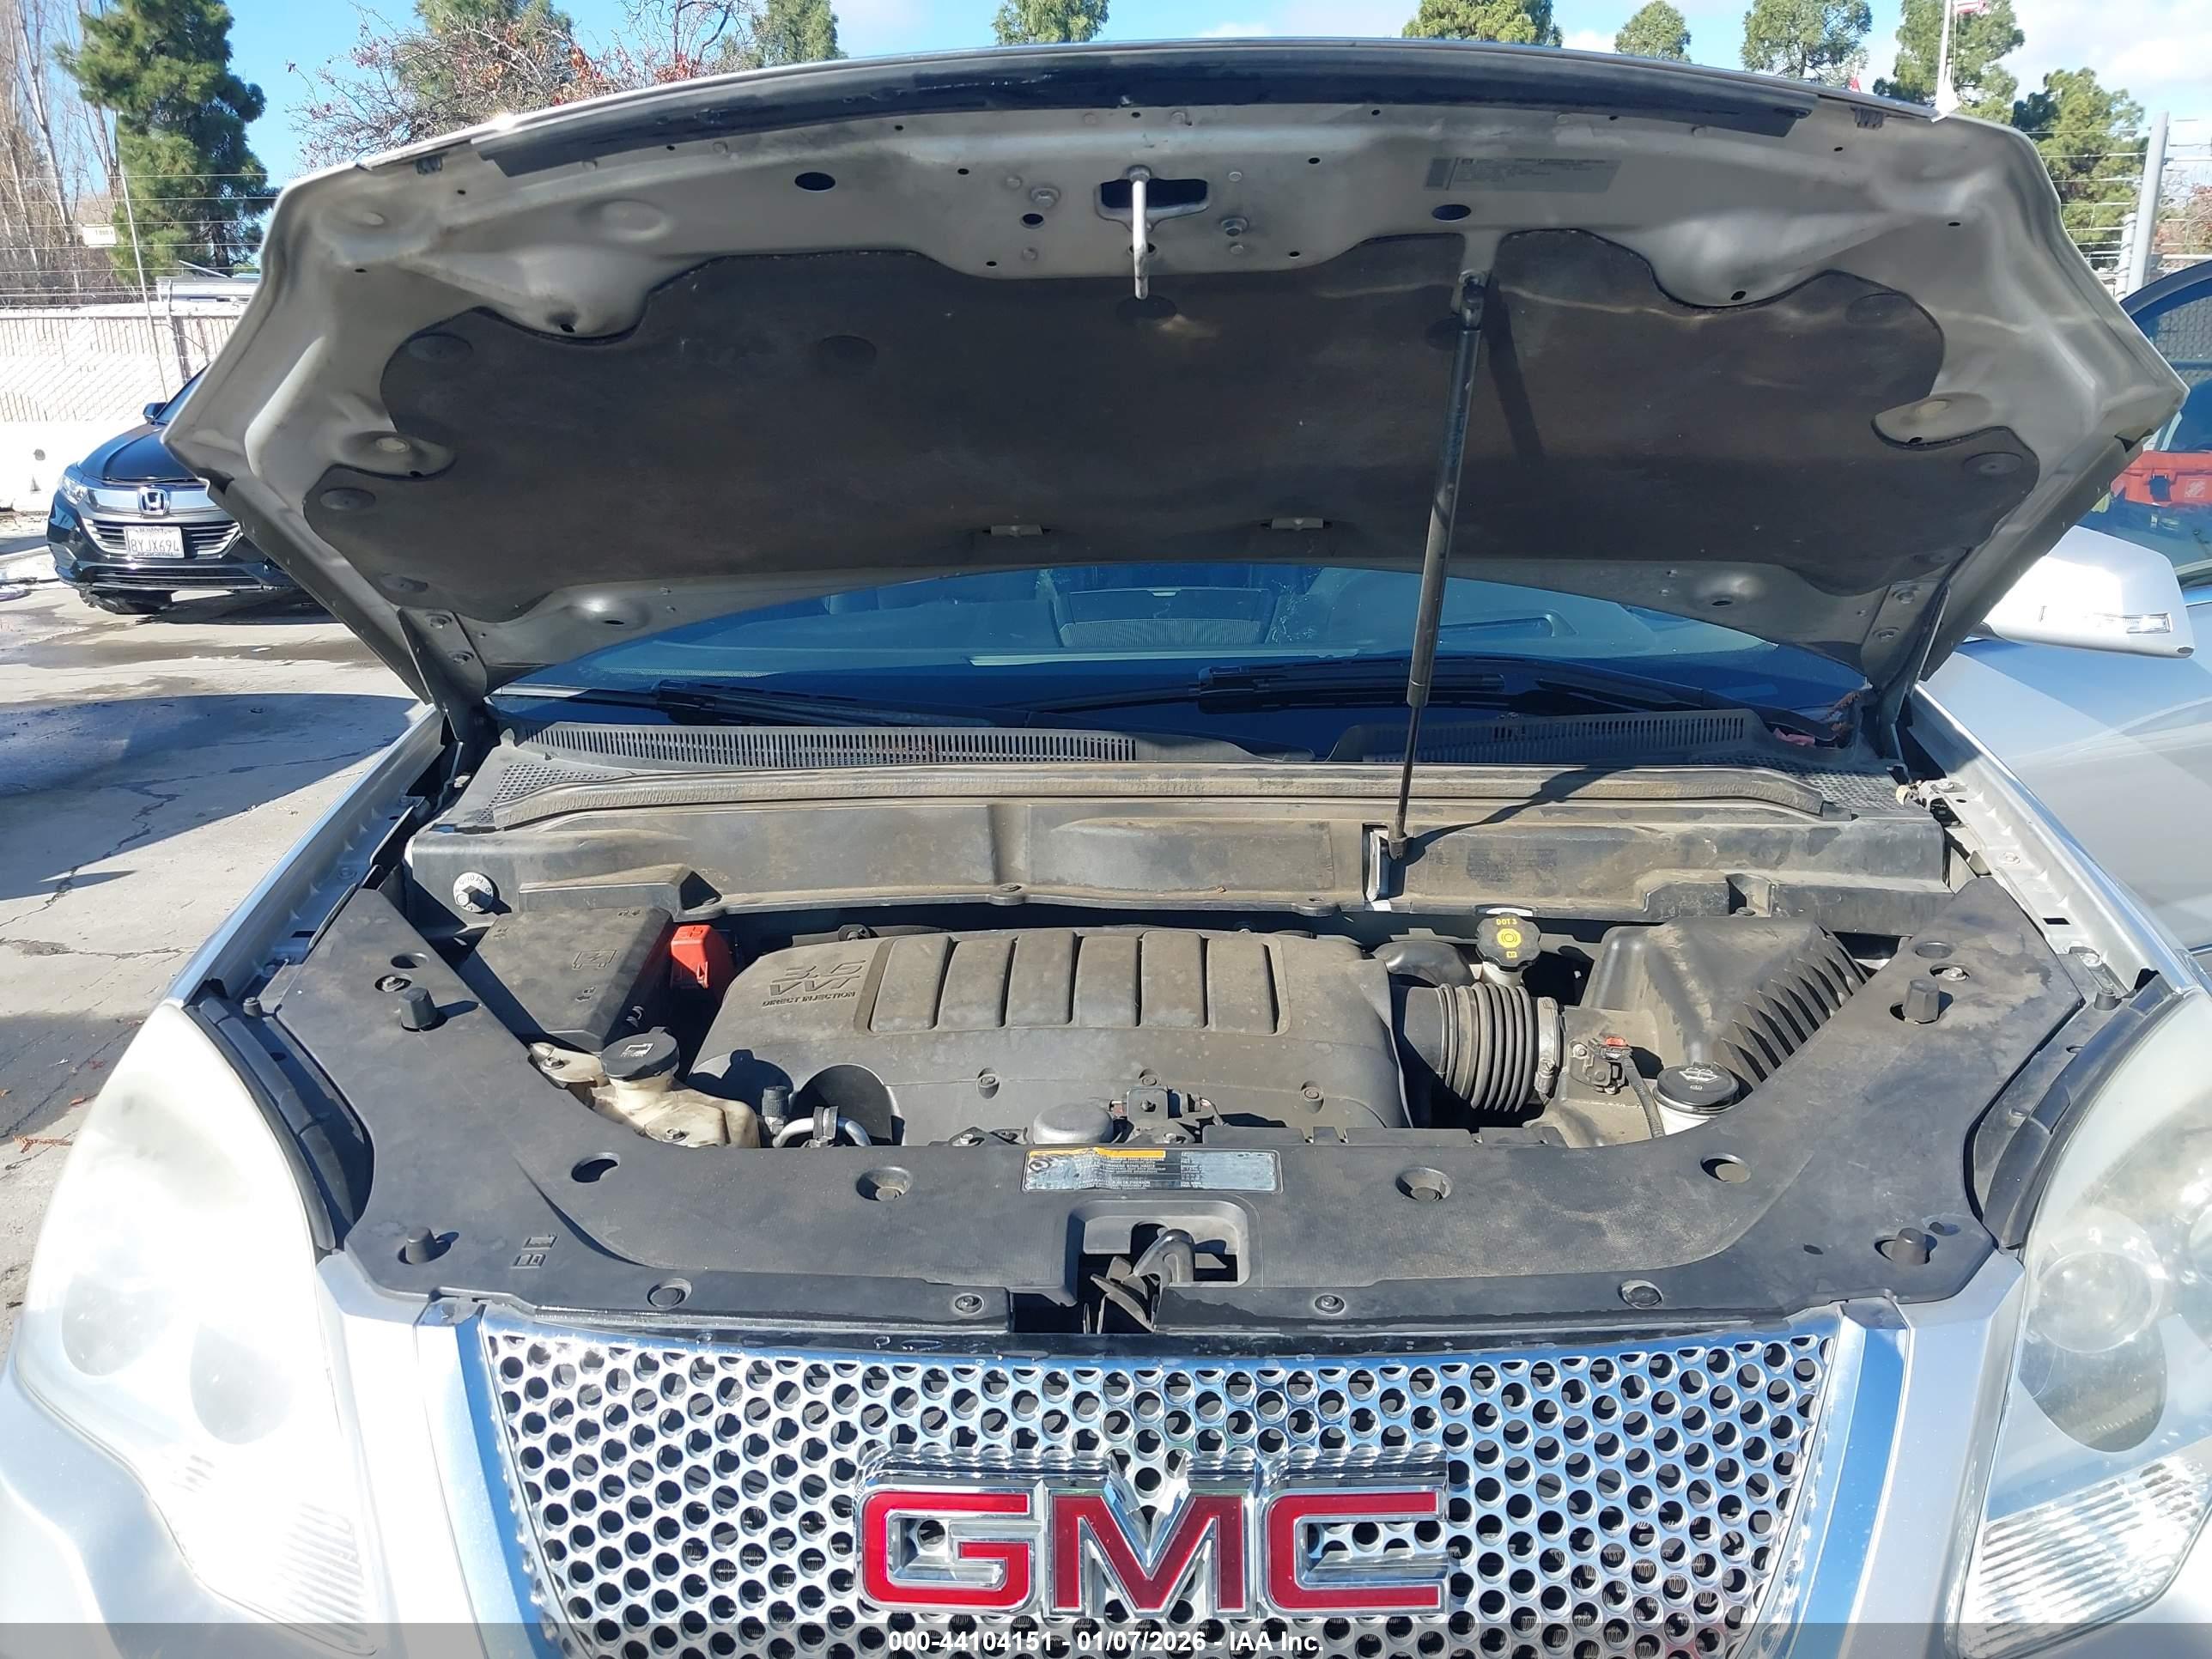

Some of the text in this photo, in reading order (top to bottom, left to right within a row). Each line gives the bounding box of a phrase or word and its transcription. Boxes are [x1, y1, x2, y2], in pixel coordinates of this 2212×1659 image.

[771, 960, 866, 983] 3.6
[762, 991, 856, 1007] DIRECT INJECTION
[860, 1488, 1444, 1614] GMC
